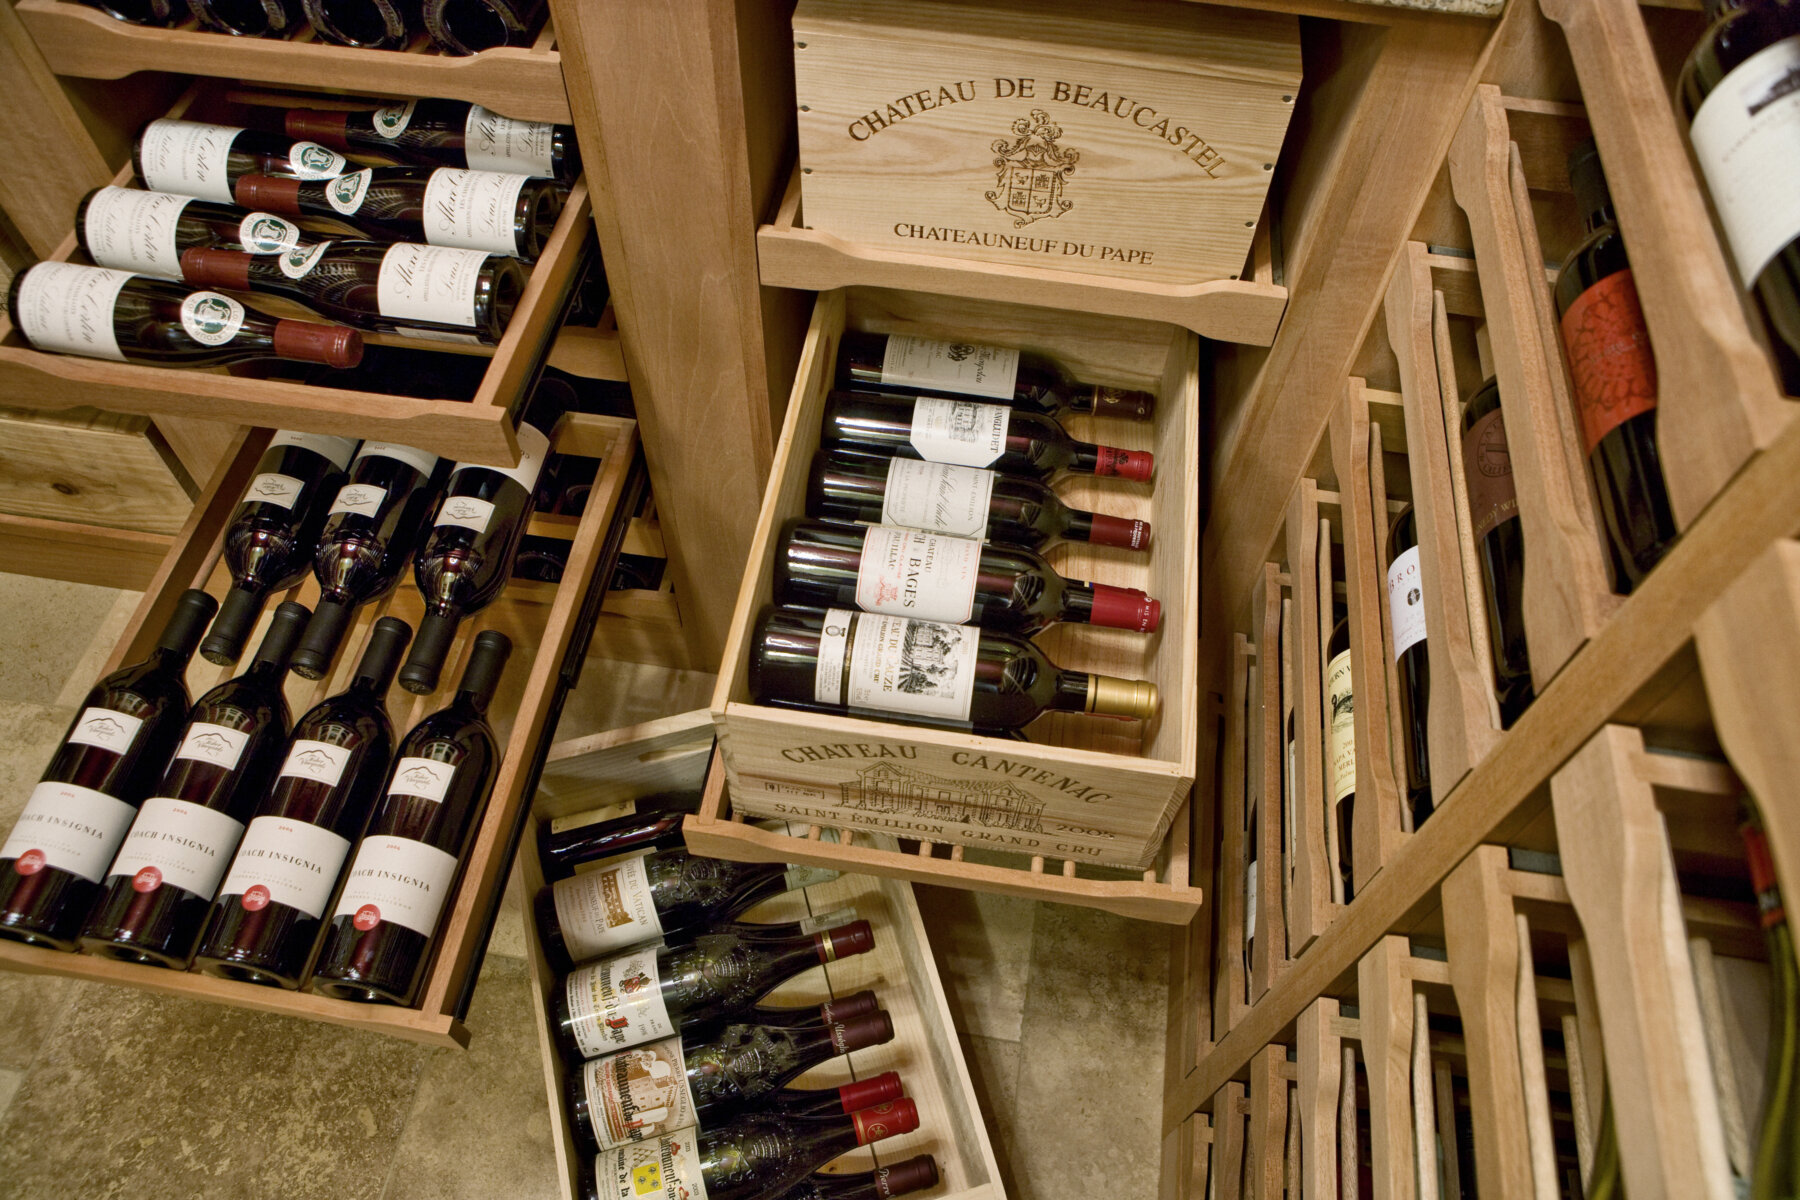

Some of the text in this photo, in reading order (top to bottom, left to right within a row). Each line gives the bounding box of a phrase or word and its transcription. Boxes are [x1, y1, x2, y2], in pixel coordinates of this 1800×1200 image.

[848, 77, 1228, 181] CHATEAU DE BEAUCASTEL
[893, 223, 1154, 265] CHATEAUNEUF DU PAPE
[903, 557, 922, 608] BAGES
[781, 743, 1113, 804] CHATEAU CANTENAC
[48, 815, 104, 840] INSIGNIA
[1055, 824, 1116, 840] 2005
[161, 832, 216, 857] INSIGNIA
[961, 830, 1040, 848] GRAND
[1056, 843, 1102, 857] CRU
[268, 850, 323, 875] INSIGNIA
[377, 870, 431, 893] INSIGNIA
[633, 890, 649, 926] VATICAN
[595, 917, 606, 934] PAPE
[671, 1058, 682, 1078] PIERRE
[677, 1079, 687, 1114] USSEGLIO
[619, 1171, 629, 1184] de
